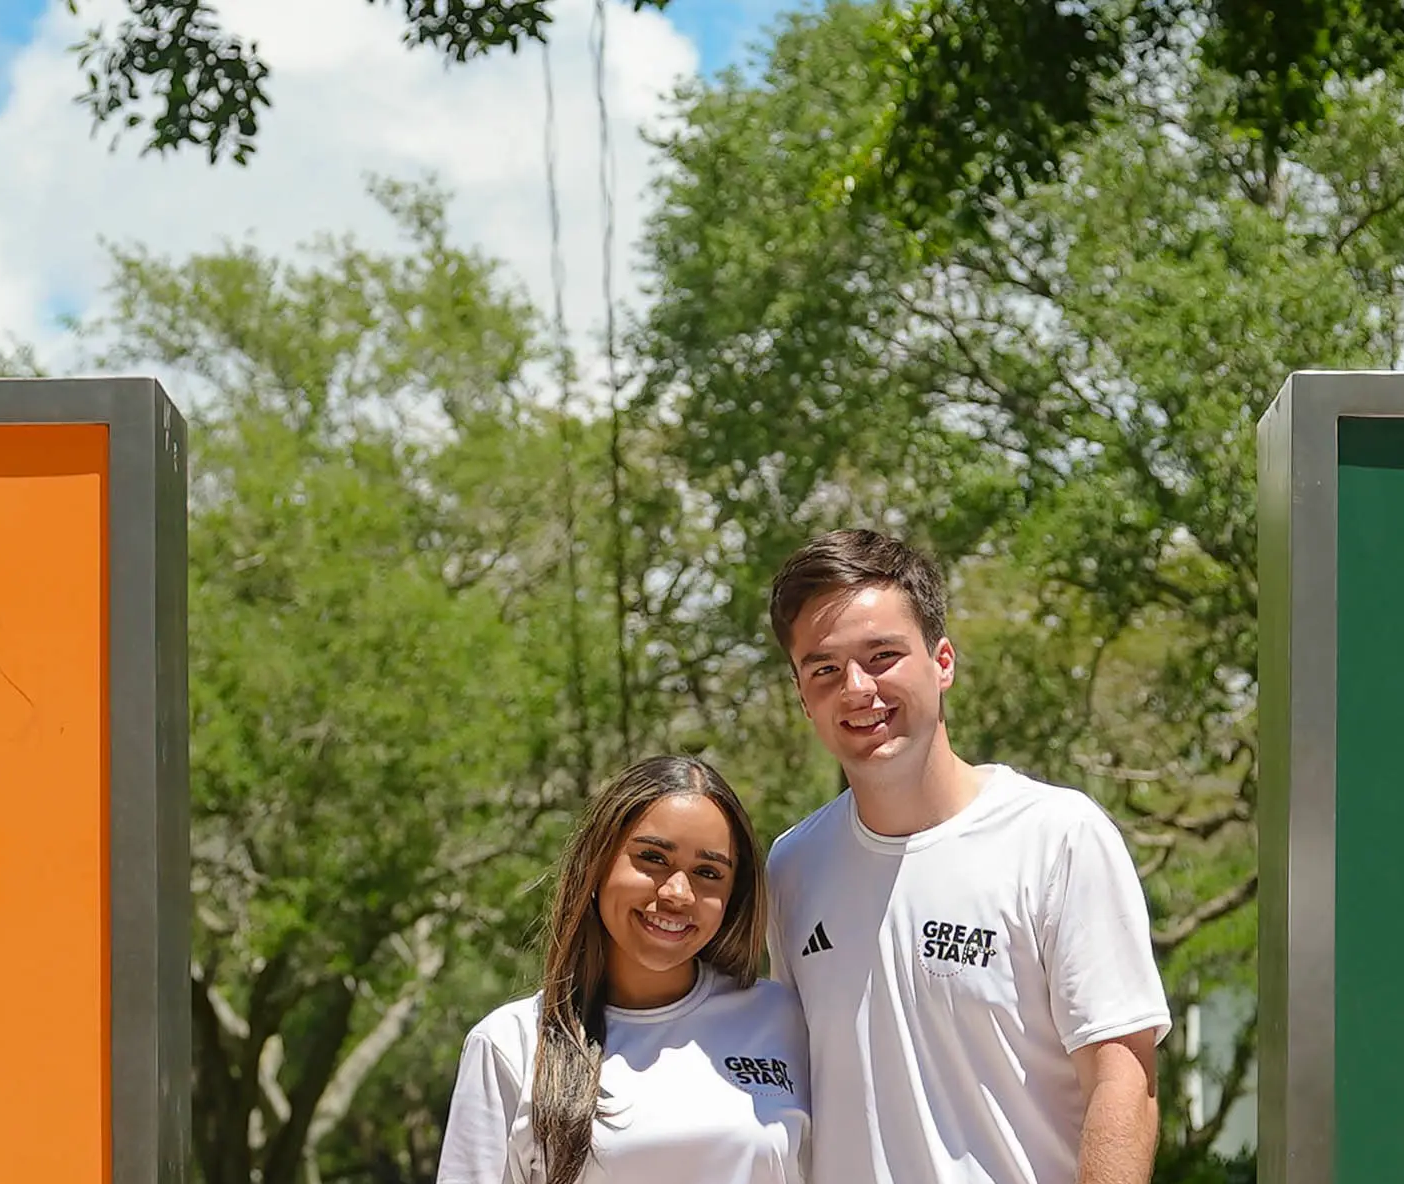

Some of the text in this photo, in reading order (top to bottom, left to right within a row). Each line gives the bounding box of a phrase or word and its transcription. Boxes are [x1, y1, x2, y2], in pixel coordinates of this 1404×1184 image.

[923, 920, 997, 949] GREAT
[923, 940, 996, 968] START
[724, 1056, 788, 1080] GREAT
[735, 1071, 794, 1095] START
